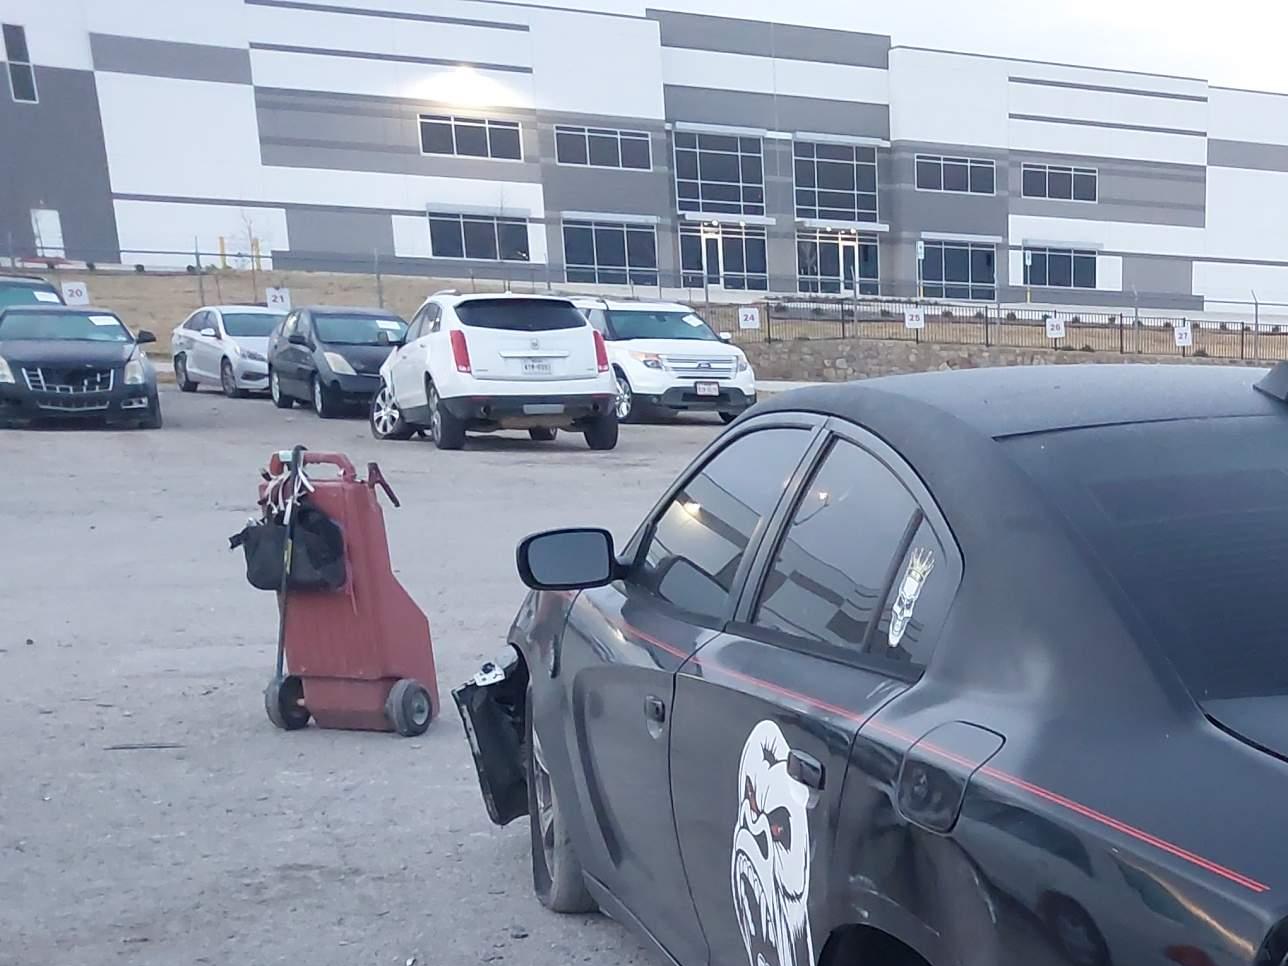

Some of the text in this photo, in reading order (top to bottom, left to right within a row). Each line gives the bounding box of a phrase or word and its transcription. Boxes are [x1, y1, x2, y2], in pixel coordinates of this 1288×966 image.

[67, 288, 83, 298] 20
[271, 294, 284, 304] 21
[743, 313, 755, 322] 24
[1178, 331, 1188, 340] 27
